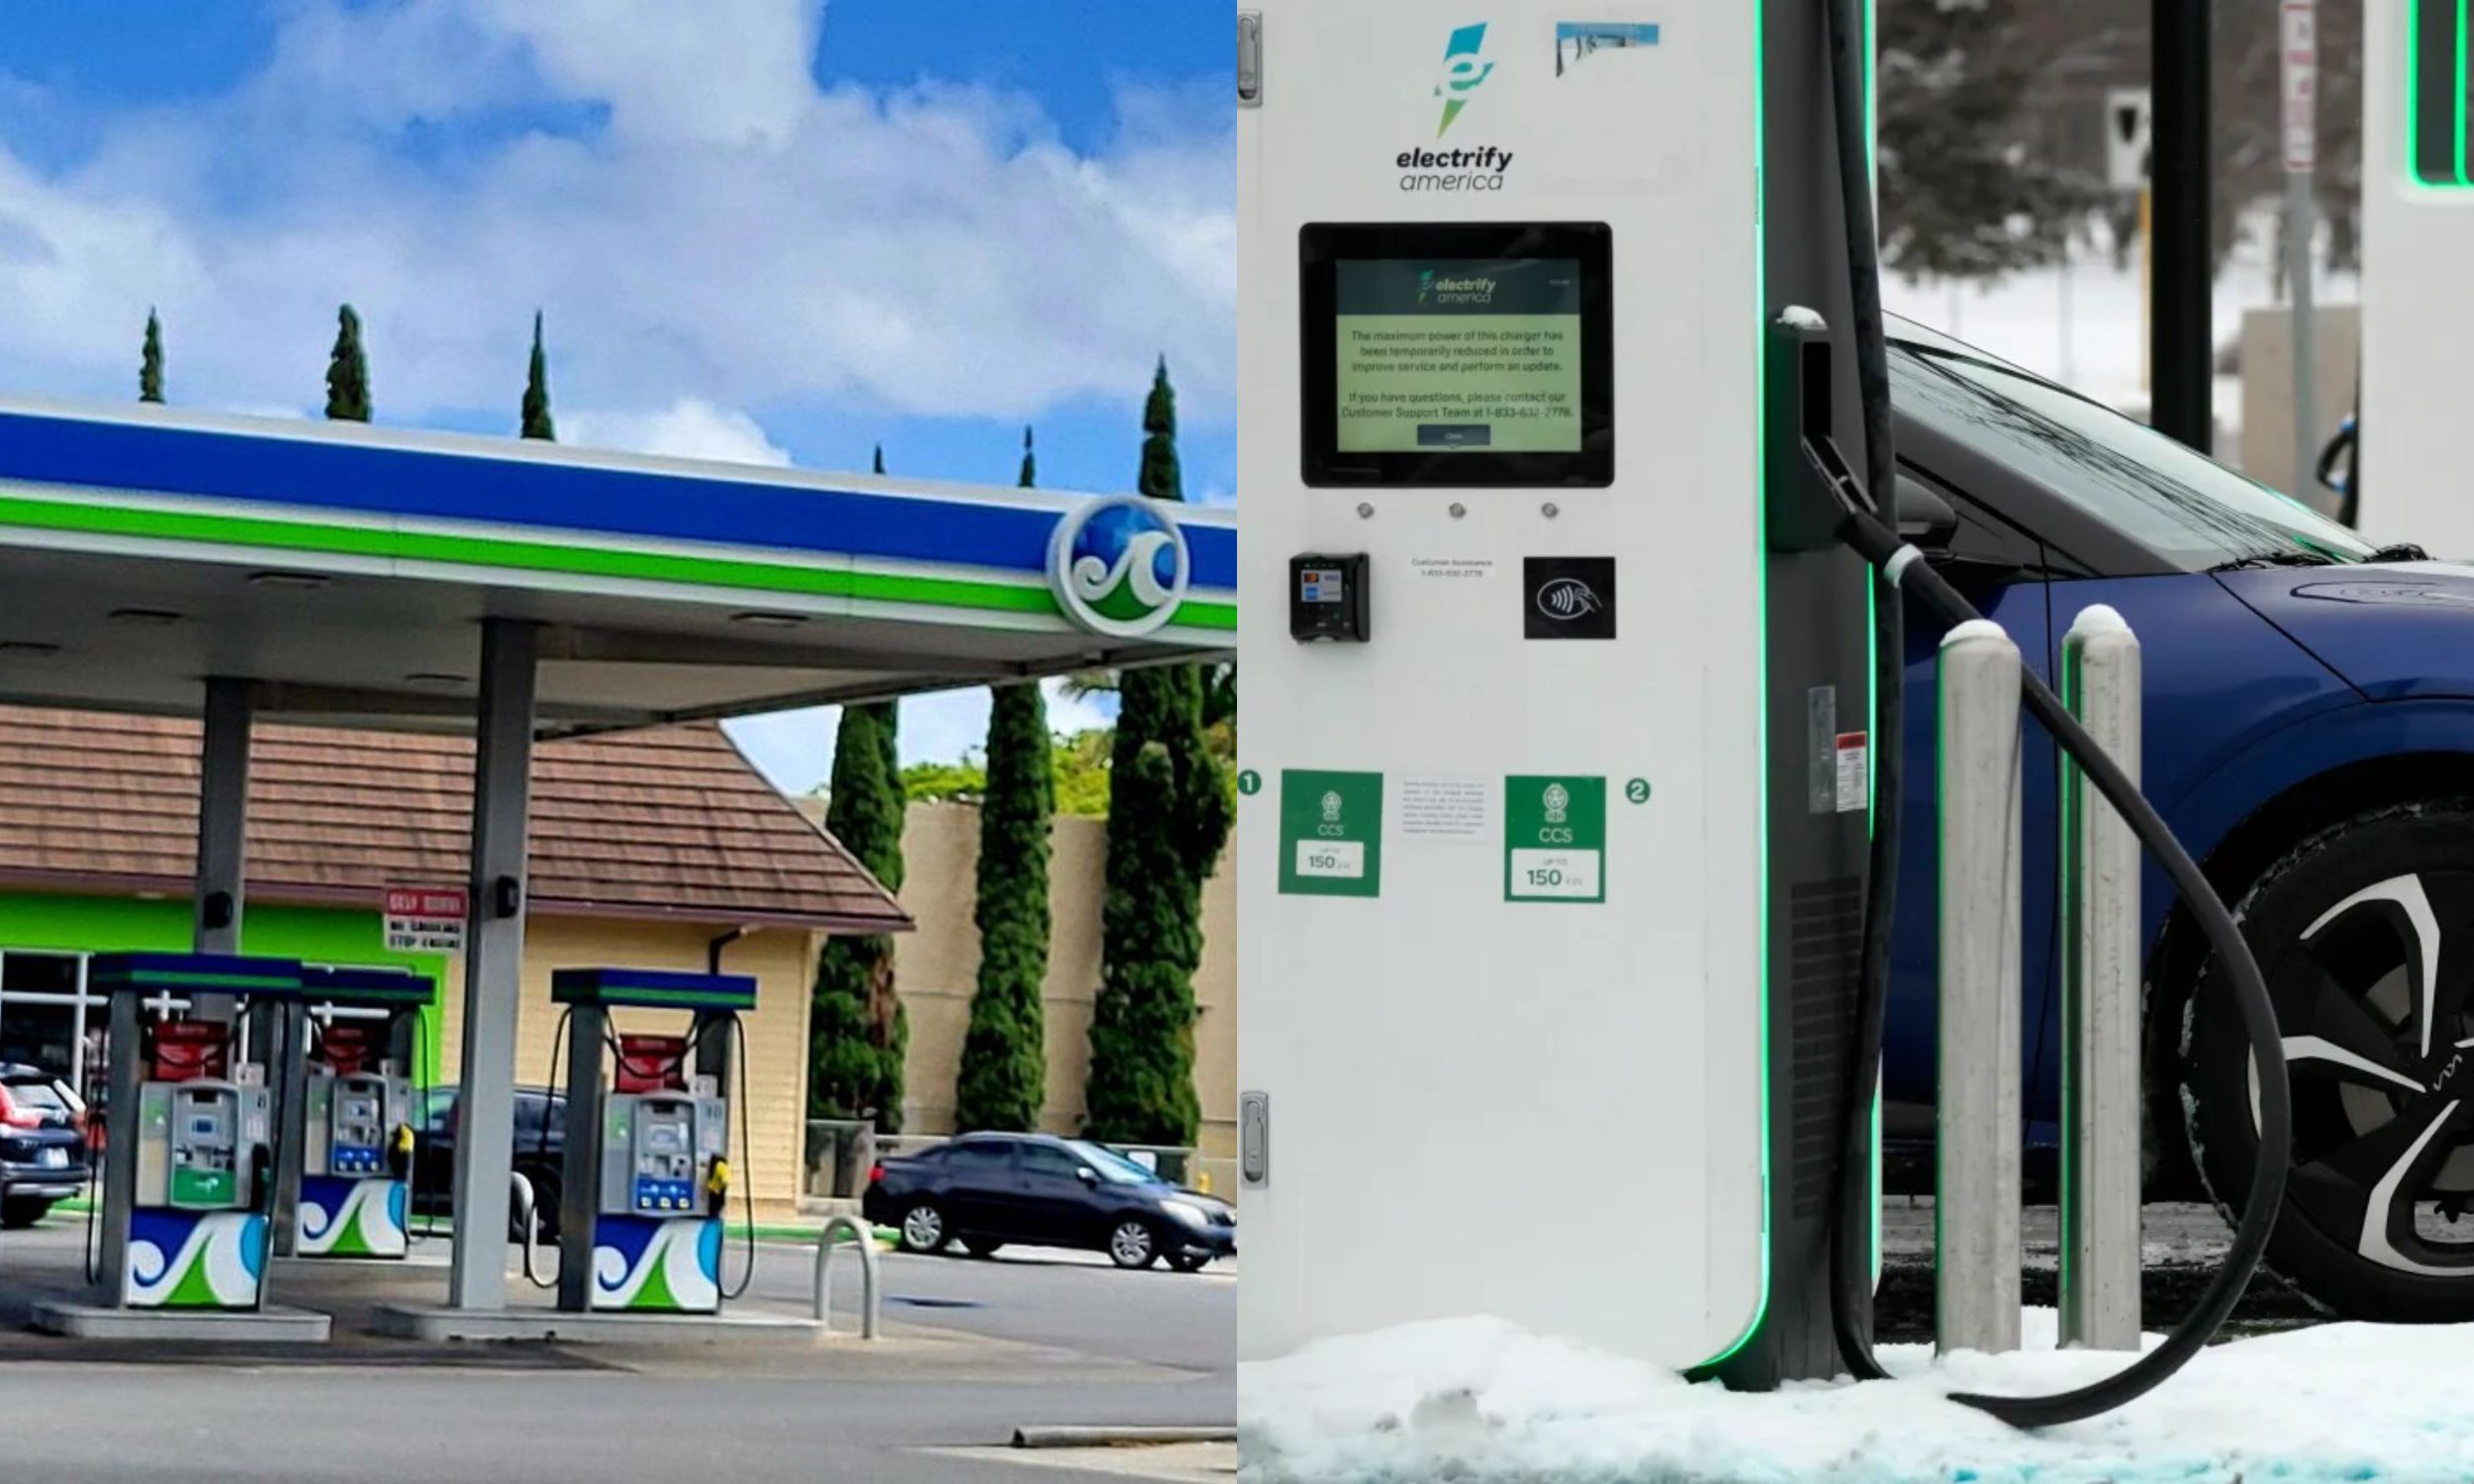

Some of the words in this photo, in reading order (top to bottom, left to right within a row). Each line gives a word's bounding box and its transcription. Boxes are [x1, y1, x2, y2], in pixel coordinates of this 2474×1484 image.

[1396, 146, 1512, 172] electrify
[1399, 170, 1503, 191] america
[1435, 278, 1495, 294] electrify
[1437, 292, 1491, 304] america
[1352, 330, 1371, 340] The
[1374, 330, 1426, 340] maximum
[1428, 331, 1462, 343] power
[1465, 330, 1475, 340] of
[1477, 330, 1497, 340] this
[1500, 330, 1542, 343] charger
[1545, 330, 1564, 341] has
[1360, 346, 1387, 356] been
[1389, 346, 1451, 359] temporarily
[1454, 346, 1497, 357] reduced
[1499, 346, 1510, 356] in
[1511, 346, 1540, 357] order
[1543, 346, 1554, 357] to
[1352, 361, 1395, 374] improve
[1397, 361, 1436, 372] service
[1439, 361, 1459, 372] and
[1461, 361, 1505, 374] perform
[1507, 363, 1521, 372] an
[1523, 361, 1564, 374] update.
[1349, 392, 1358, 403] If
[1359, 394, 1379, 406] you
[1380, 392, 1406, 403] have
[1408, 392, 1465, 406] questions,
[1468, 392, 1502, 406] please
[1504, 393, 1546, 404] contact
[1548, 395, 1567, 404] our
[1342, 407, 1393, 417] Customer
[1395, 407, 1439, 420] Support
[1442, 407, 1473, 417] Team
[1474, 407, 1483, 417] at
[1244, 774, 1253, 791] 1
[1631, 781, 1645, 800] 2
[1318, 824, 1345, 836] CCS
[1539, 828, 1573, 843] CCS
[1309, 855, 1335, 869] 150
[1527, 870, 1563, 886] 150
